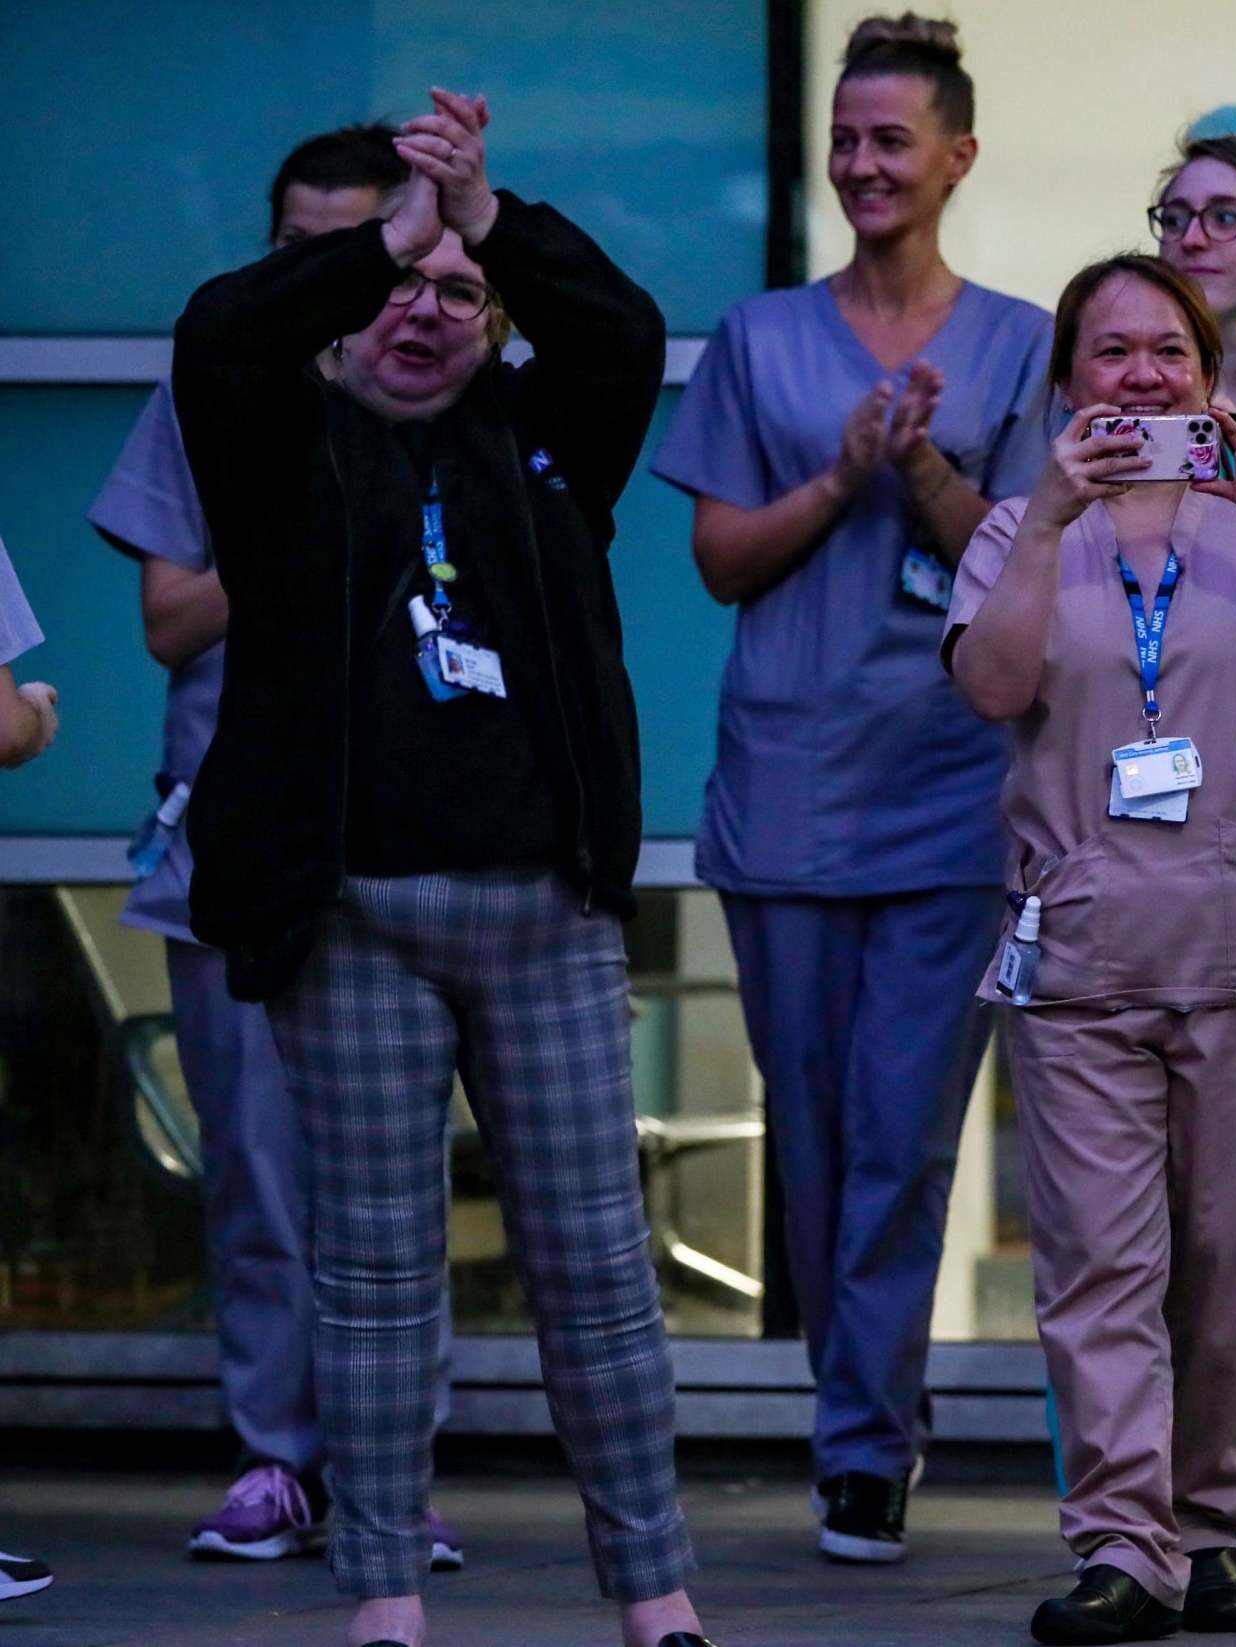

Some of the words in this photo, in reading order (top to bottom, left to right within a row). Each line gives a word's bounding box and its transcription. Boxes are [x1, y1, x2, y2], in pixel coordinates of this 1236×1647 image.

[1135, 616, 1148, 639] NHS
[1151, 610, 1164, 632] NHS
[1147, 640, 1159, 664] NHS
